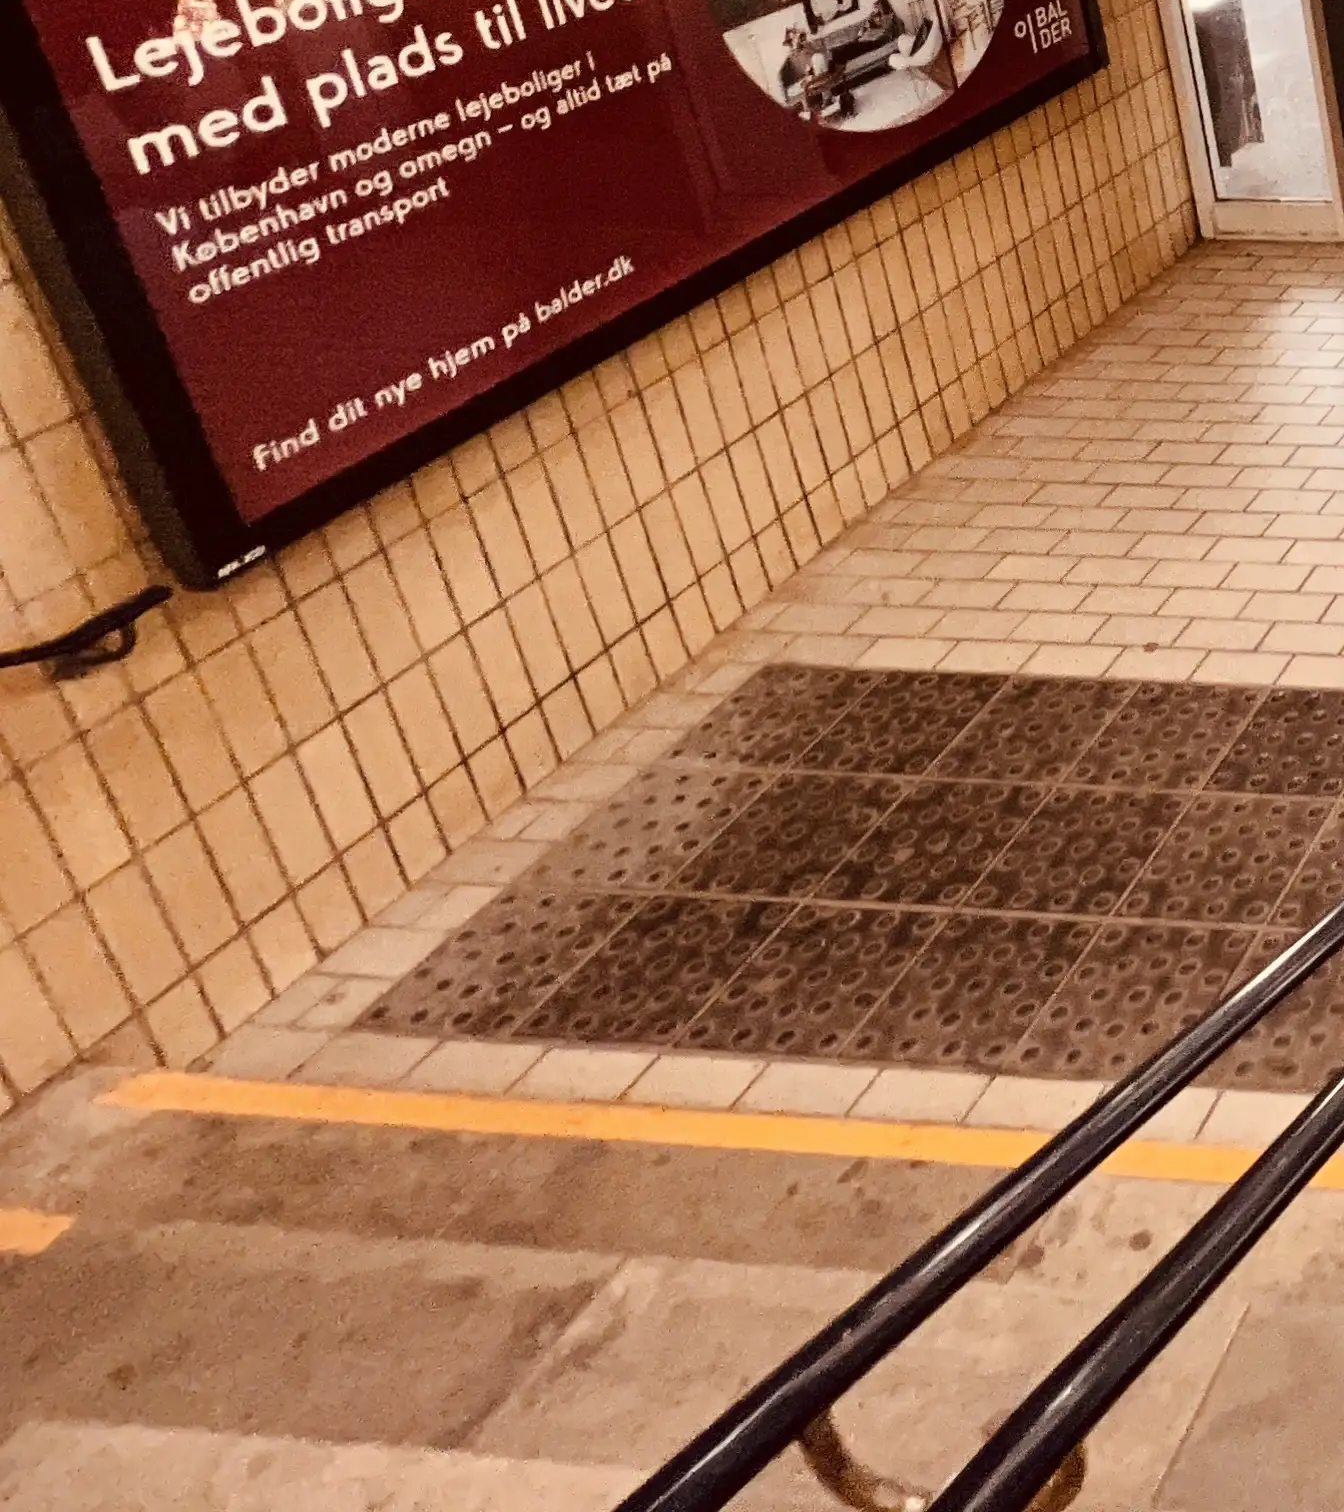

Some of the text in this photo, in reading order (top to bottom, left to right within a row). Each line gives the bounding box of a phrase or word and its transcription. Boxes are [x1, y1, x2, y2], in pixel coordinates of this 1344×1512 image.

[127, 75, 288, 175] med
[306, 24, 463, 128] plads
[1040, 17, 1072, 49] DER
[155, 51, 595, 235] Vi tilbyder moderne lejeboliger i
[172, 188, 347, 272] København
[355, 170, 393, 197] og
[399, 130, 492, 179] omegn
[520, 106, 551, 130] og
[556, 77, 601, 115] altid
[605, 62, 642, 93] tæt
[646, 52, 672, 83] på
[188, 176, 450, 304] offentlig transport
[251, 255, 635, 472] Find dit nye hjem på balder.dk
